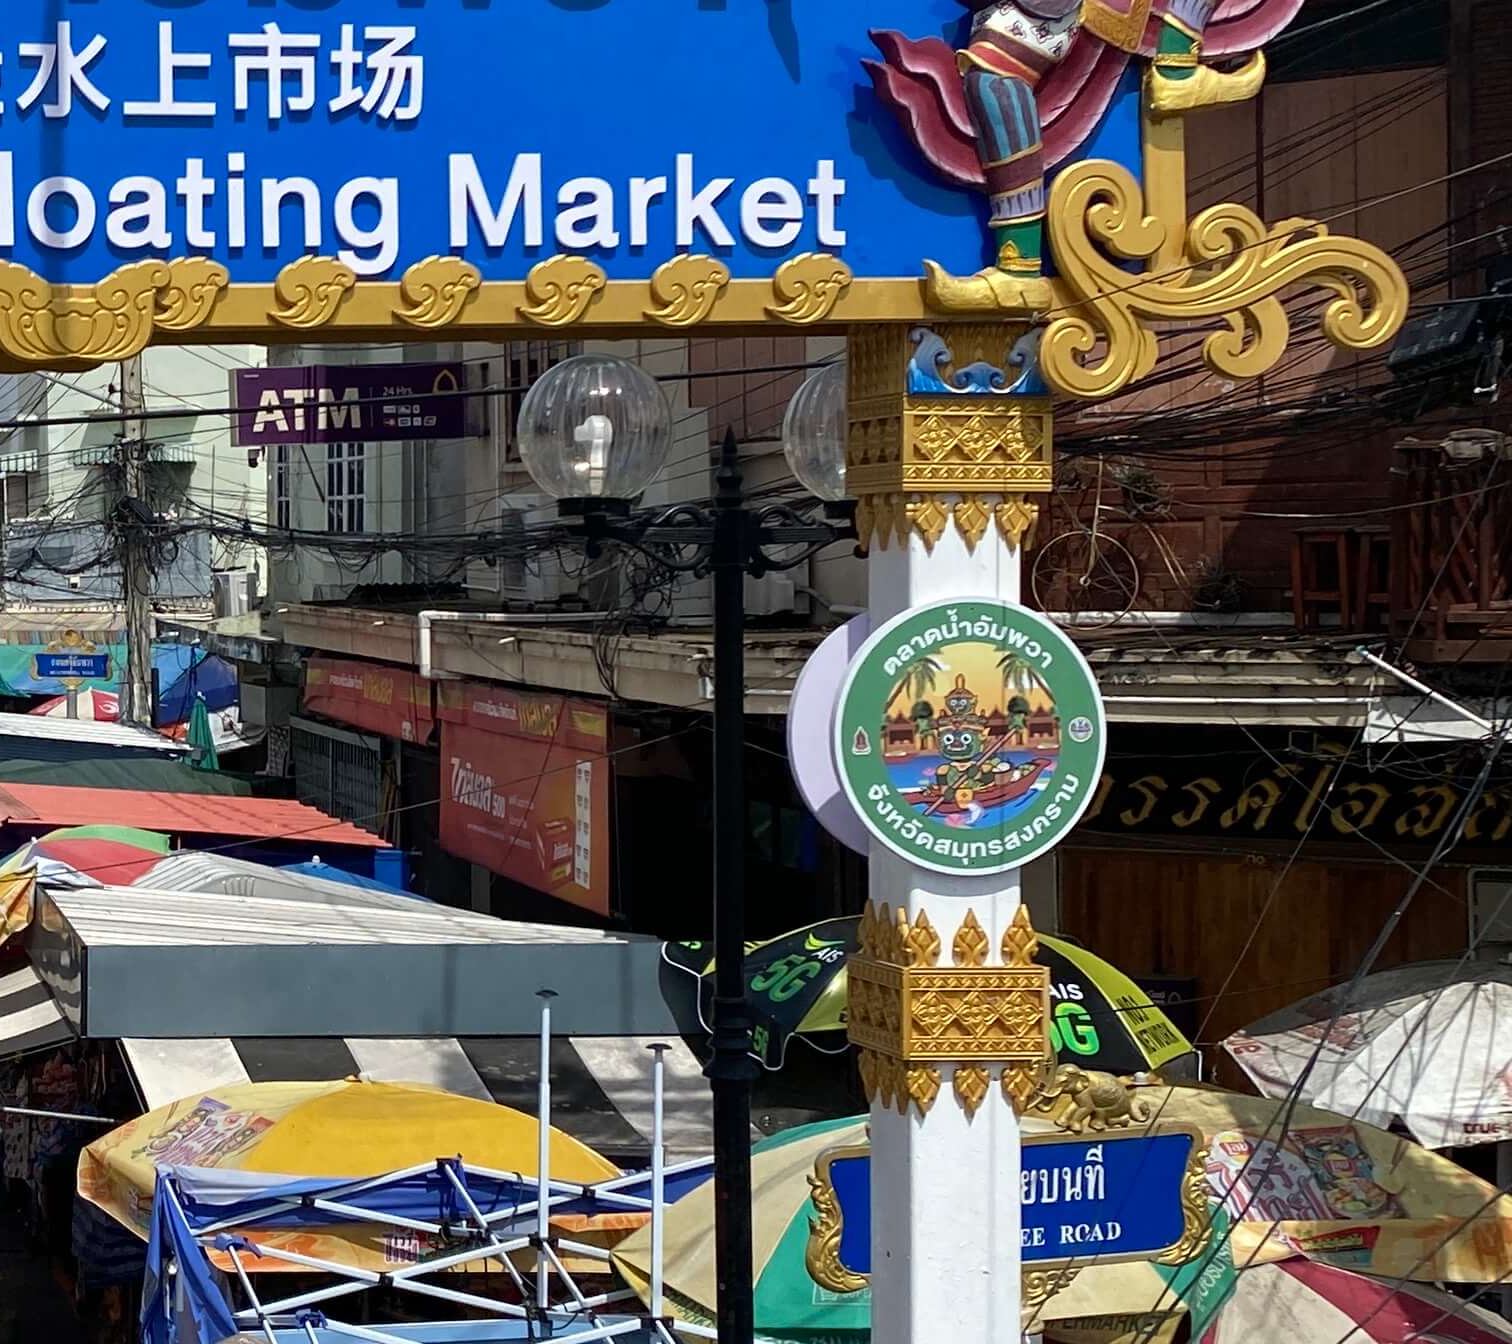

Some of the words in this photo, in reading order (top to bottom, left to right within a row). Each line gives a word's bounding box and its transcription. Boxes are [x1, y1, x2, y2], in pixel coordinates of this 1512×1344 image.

[448, 152, 847, 248] Market
[253, 387, 362, 433] ATM
[883, 608, 1054, 677] ตลาดน้ำอัมพวา
[867, 773, 1080, 865] จังหวัดสมุทรสงคราม
[750, 953, 823, 1003] 5G
[810, 946, 845, 964] AIS
[1048, 983, 1085, 1001] AIS
[1049, 1001, 1100, 1056] G
[1059, 1221, 1122, 1245] ROAD
